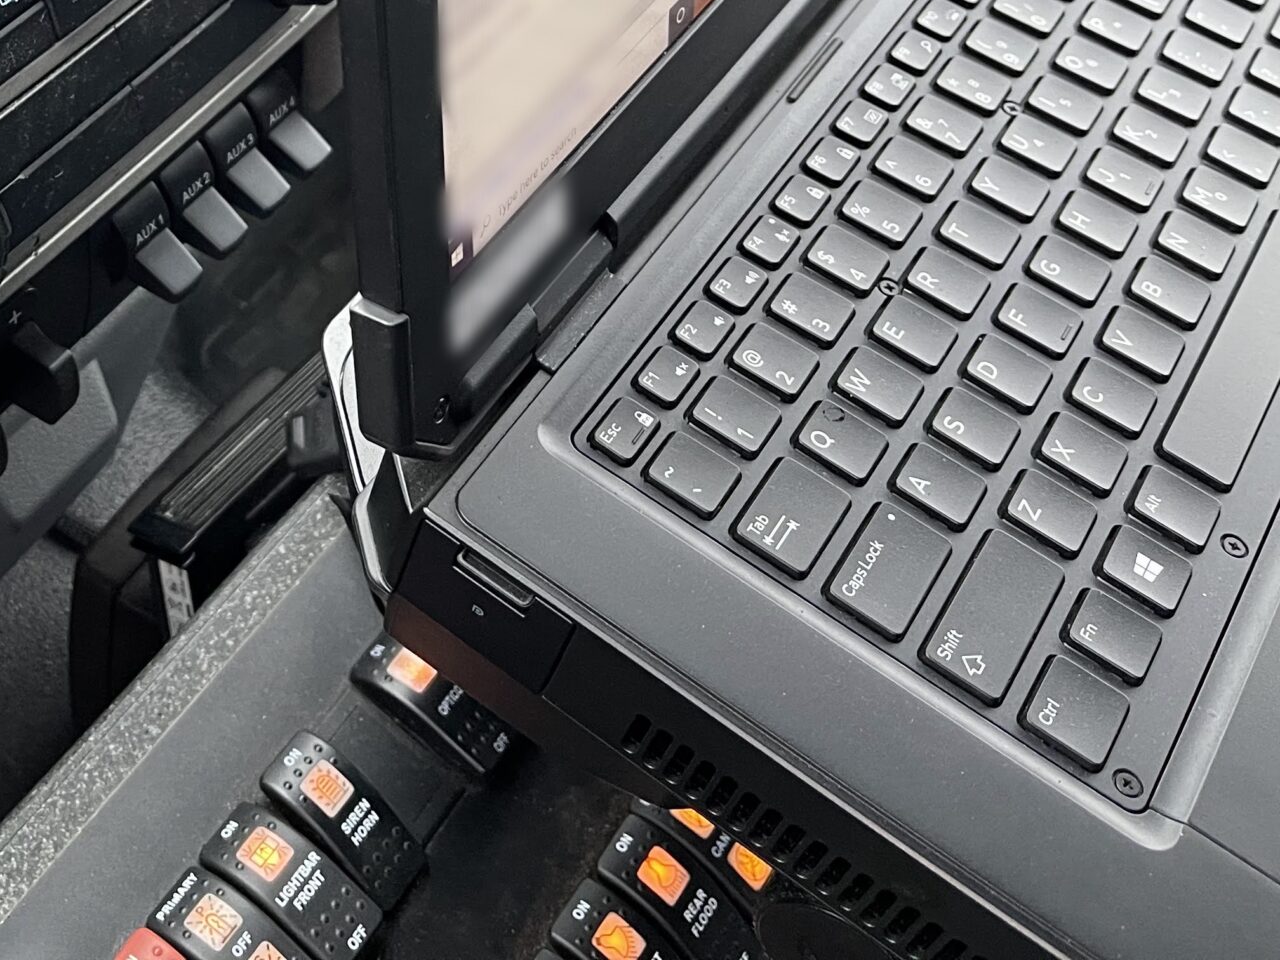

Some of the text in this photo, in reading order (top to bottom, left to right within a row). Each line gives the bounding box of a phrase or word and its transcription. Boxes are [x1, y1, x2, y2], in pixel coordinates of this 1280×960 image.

[1089, 17, 1106, 31] P
[1064, 55, 1083, 69] O
[269, 95, 296, 125] AUX 4
[839, 116, 855, 132] F7
[1122, 125, 1144, 141] K
[945, 131, 961, 144] 7
[1008, 134, 1029, 150] U
[226, 132, 255, 164] AUX 3
[810, 155, 827, 170] F6
[914, 174, 933, 187] 6
[979, 176, 1001, 192] Y
[1098, 168, 1116, 183] J
[182, 171, 211, 205] AUX 2
[1190, 186, 1214, 206] M
[780, 194, 796, 210] F5
[136, 213, 165, 247] AUX 1
[881, 219, 901, 235] 5
[1068, 211, 1091, 230] H
[947, 222, 970, 239] T
[747, 235, 765, 251] F4
[1169, 232, 1190, 251] N
[849, 267, 868, 282] 4
[1040, 259, 1061, 276] G
[714, 278, 732, 294] F3
[916, 271, 941, 289] R
[1141, 280, 1163, 298] B
[812, 318, 831, 333] 3
[1008, 308, 1028, 327] F
[680, 323, 698, 340] F2
[882, 321, 906, 340] E
[1111, 329, 1133, 347] V
[741, 349, 765, 369] @
[775, 370, 795, 386] 2
[977, 360, 998, 380] D
[642, 371, 661, 389] F1
[845, 367, 872, 393] W
[1082, 386, 1105, 403] C
[599, 422, 622, 444] Esc
[736, 427, 755, 440] 1
[943, 415, 965, 435] S
[810, 430, 835, 449] Q
[1051, 439, 1076, 461] X
[908, 474, 932, 495] A
[1018, 498, 1043, 522] Z
[1144, 494, 1162, 514] Alt
[746, 514, 769, 536] Tab
[841, 539, 885, 597] Caps Lock
[1080, 623, 1098, 642] Fn
[370, 644, 385, 657] ON
[936, 628, 964, 661] Shift
[1038, 697, 1061, 726] Ctrl
[283, 748, 302, 767] ON
[340, 797, 372, 836] SIREN
[220, 820, 239, 839] ON
[350, 810, 380, 847] HORN
[615, 833, 634, 853] ON
[275, 851, 321, 908] LIGHTBAR
[155, 872, 198, 921] PRIMARY
[293, 870, 326, 912] FRONT
[571, 899, 591, 921] ON
[682, 888, 708, 923] REAR
[690, 897, 718, 939] FLOOD
[231, 930, 253, 958] OFF
[346, 923, 368, 952] OFF
